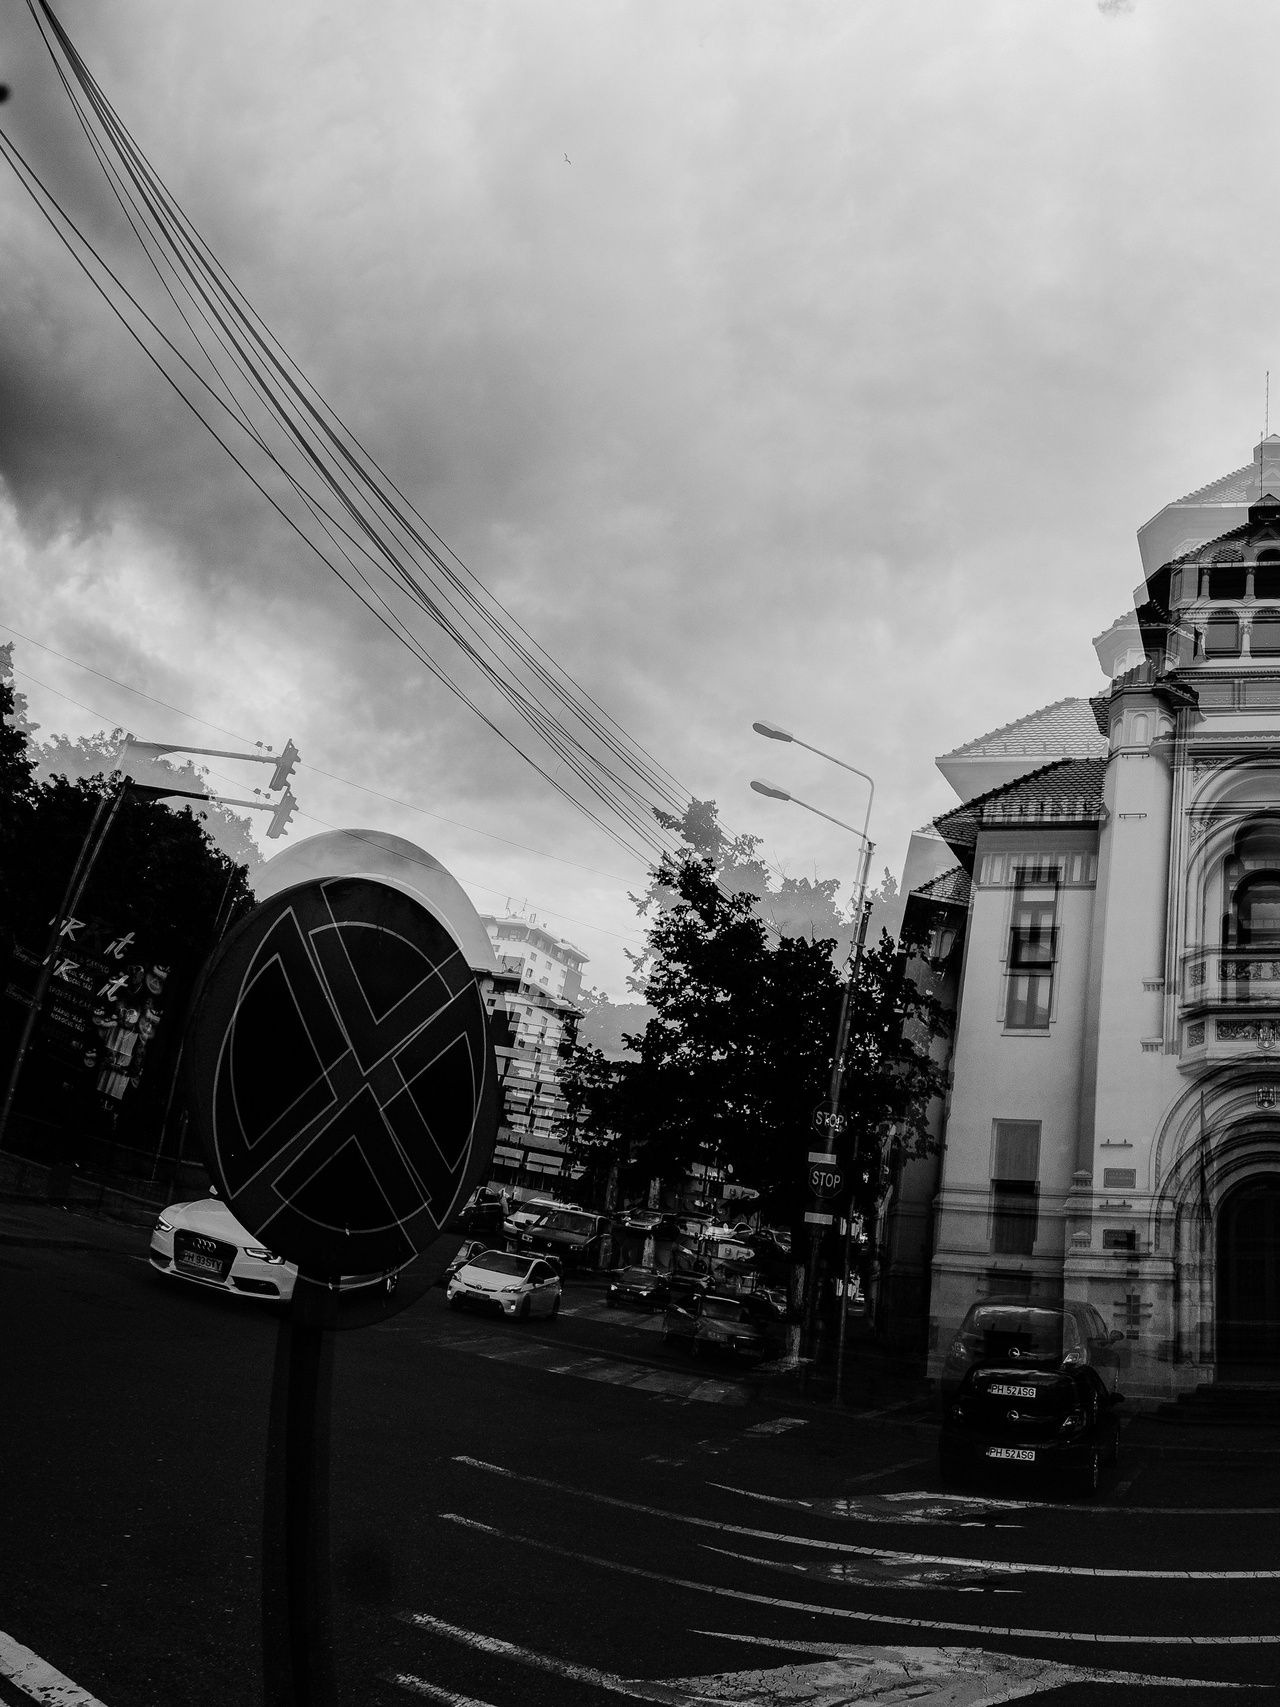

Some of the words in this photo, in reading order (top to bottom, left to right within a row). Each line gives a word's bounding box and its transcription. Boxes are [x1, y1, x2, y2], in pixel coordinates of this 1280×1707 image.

[86, 960, 110, 974] CASINO
[816, 1111, 844, 1127] STOP
[812, 1171, 841, 1188] STOP
[991, 1384, 1004, 1394] PH
[1007, 1386, 1035, 1397] 52ASG
[989, 1447, 1003, 1458] PH
[1005, 1449, 1034, 1460] 52ASG
